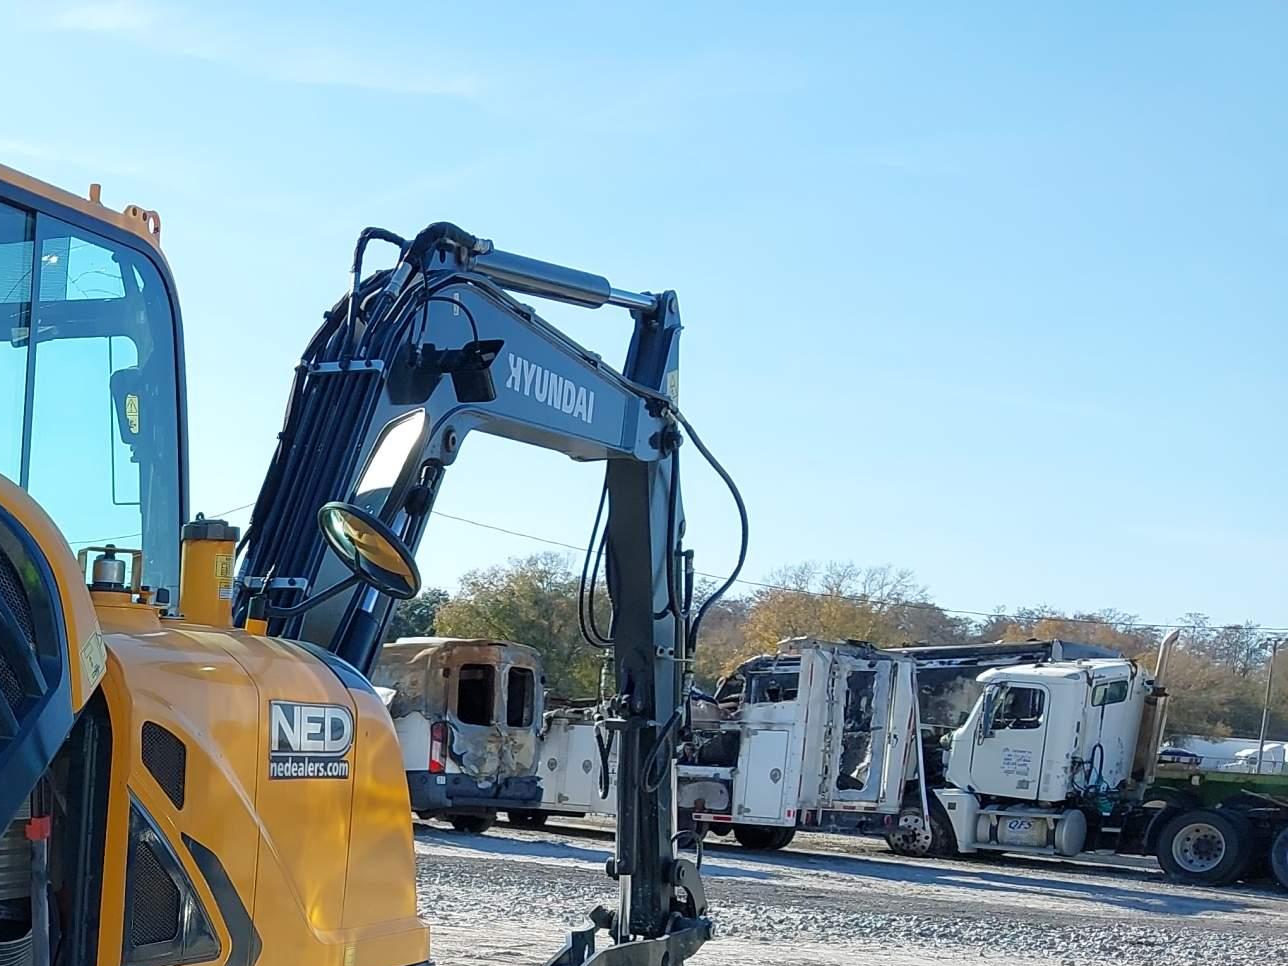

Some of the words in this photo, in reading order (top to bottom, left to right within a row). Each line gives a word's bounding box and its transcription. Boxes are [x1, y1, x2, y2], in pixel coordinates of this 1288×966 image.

[506, 353, 594, 424] HYUNDAI
[271, 704, 352, 752] NED
[270, 757, 349, 777] nedealers.com
